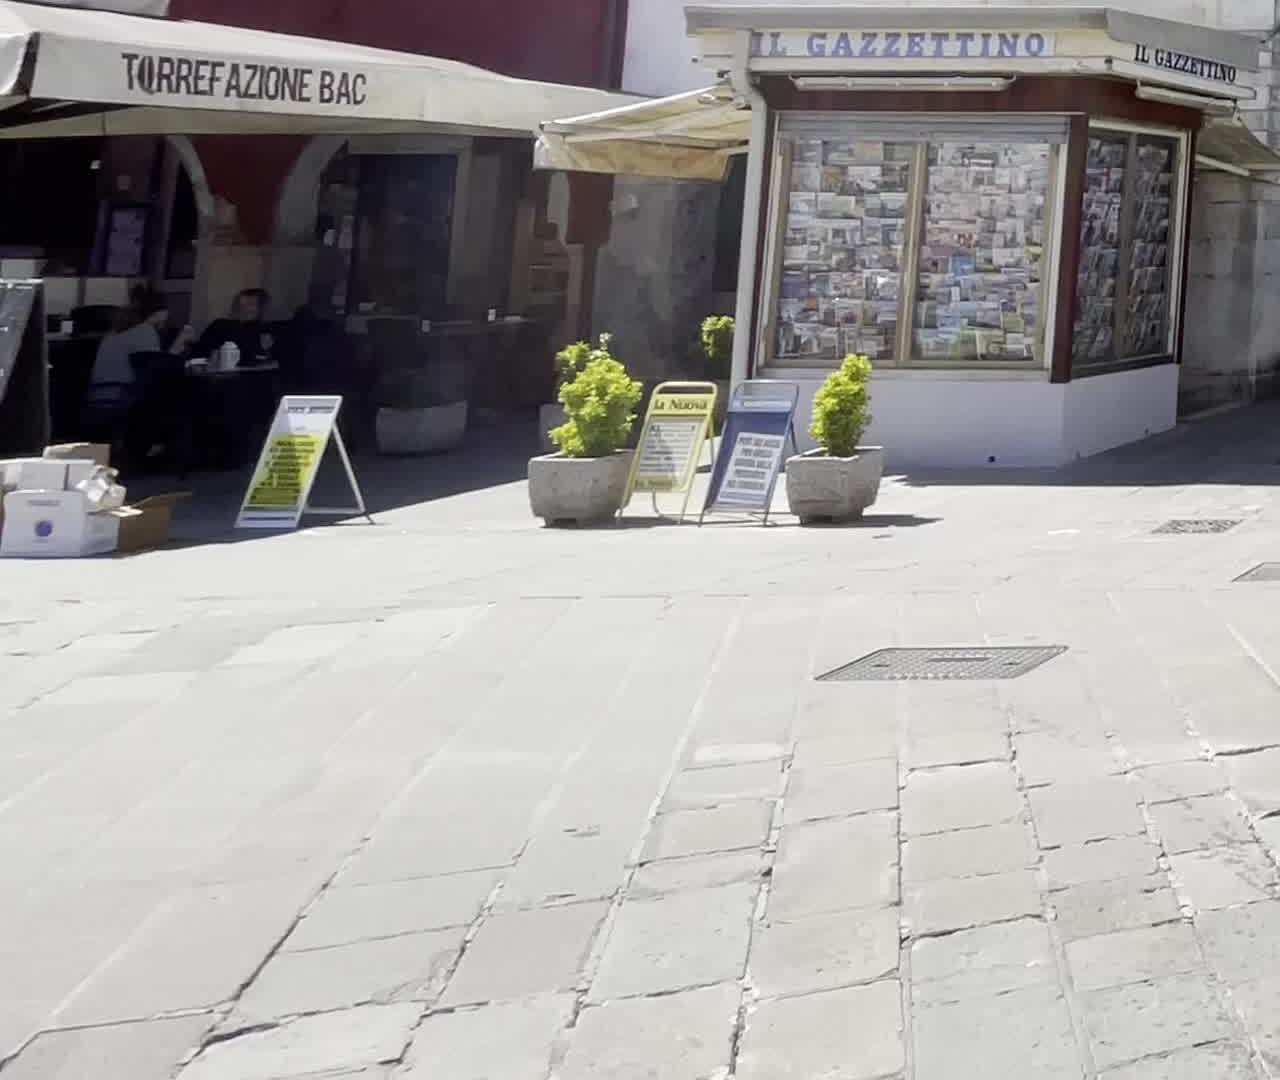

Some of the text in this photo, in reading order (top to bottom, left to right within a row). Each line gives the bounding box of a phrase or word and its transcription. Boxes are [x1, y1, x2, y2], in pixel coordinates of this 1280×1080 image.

[751, 32, 1045, 57] IL GAZZETTINO
[1134, 44, 1237, 83] IL GAZZETTINO
[121, 52, 367, 105] TORREFAZIONE BAC
